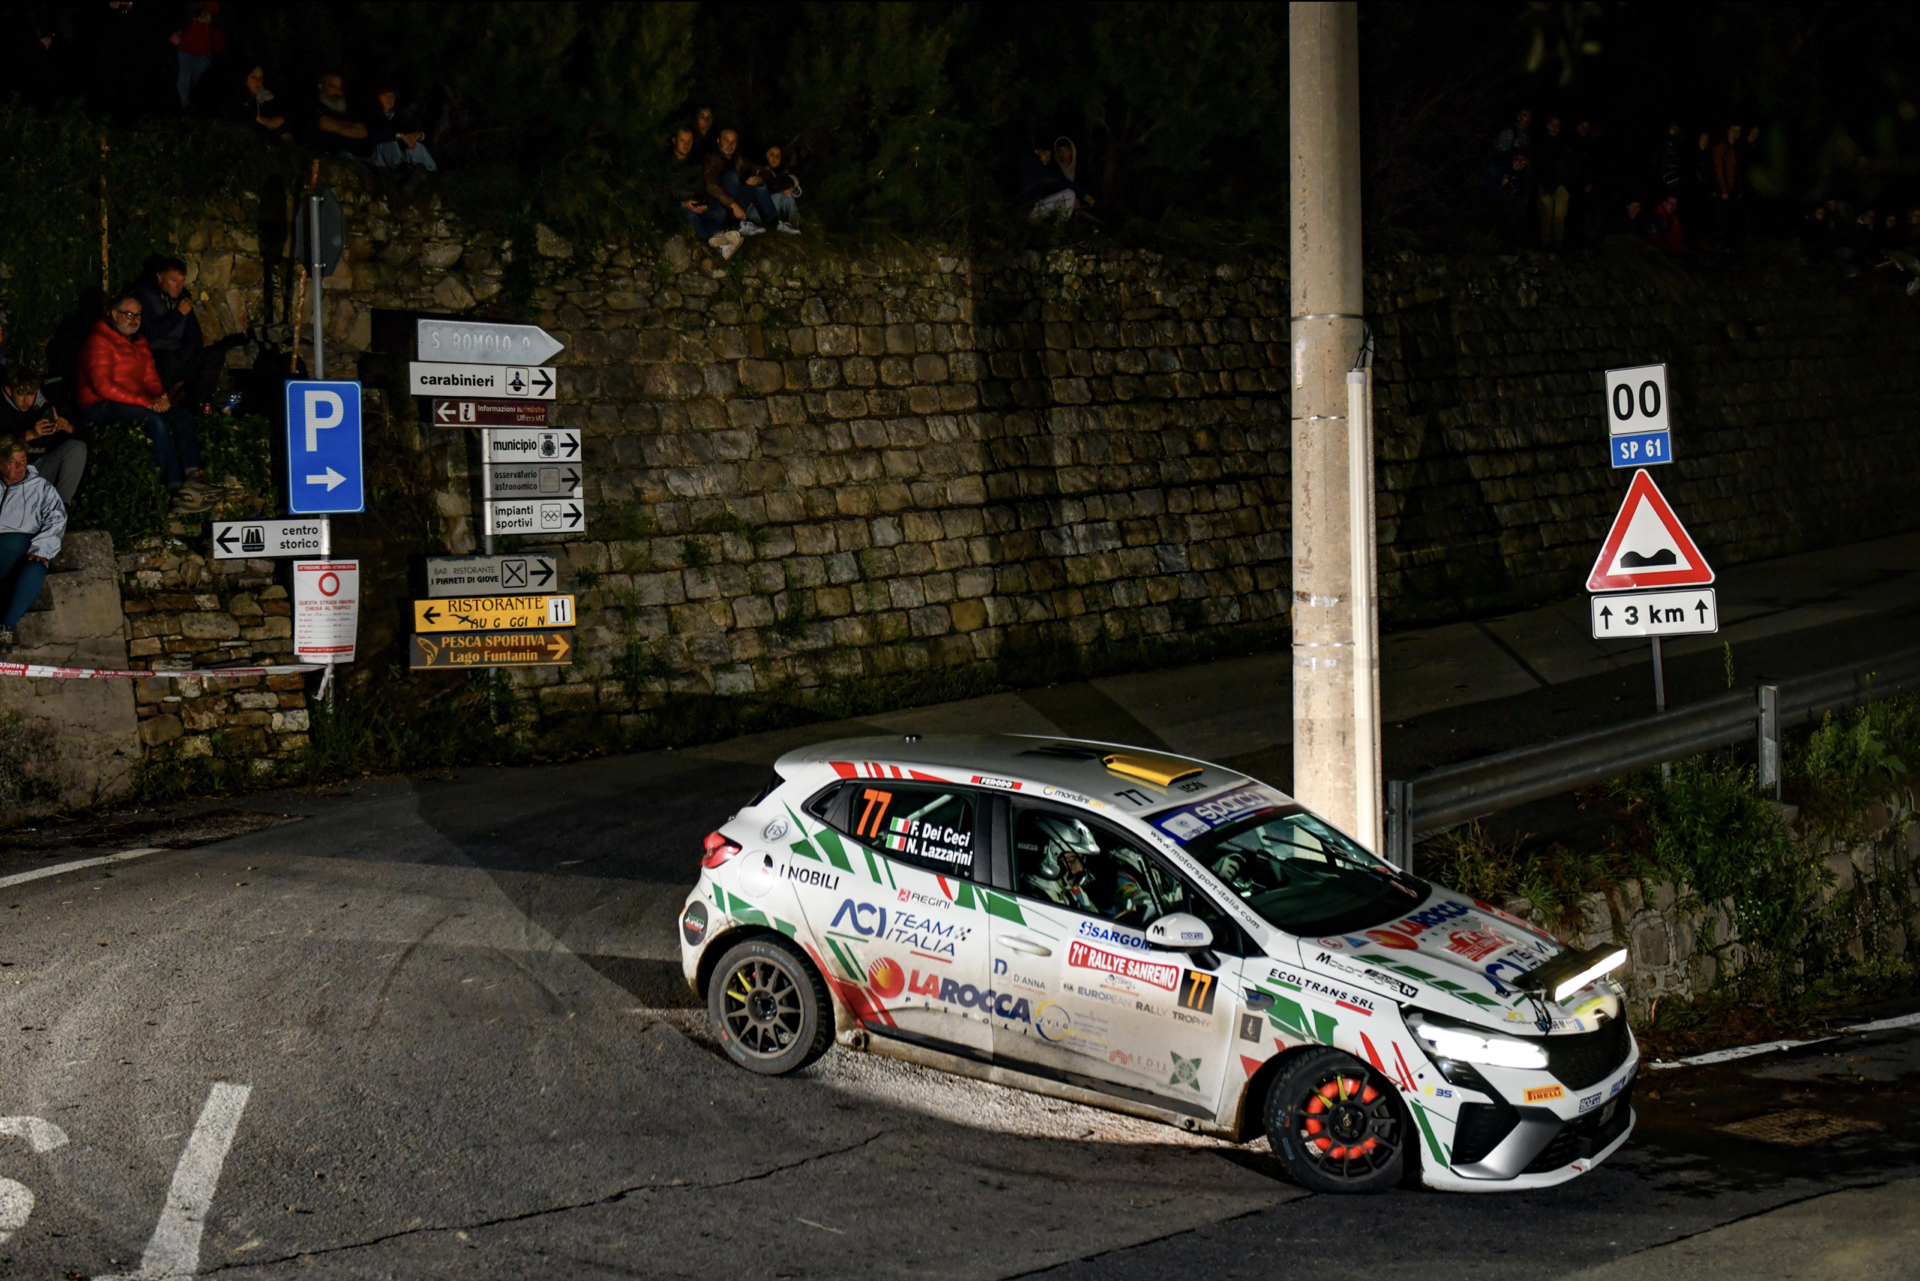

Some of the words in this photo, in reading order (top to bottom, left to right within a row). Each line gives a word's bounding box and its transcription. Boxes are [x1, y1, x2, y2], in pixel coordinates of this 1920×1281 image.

[452, 332, 512, 353] ROMOLO
[420, 374, 494, 387] carabinieri
[477, 404, 516, 413] Informazioni
[1612, 380, 1661, 421] 00
[304, 390, 344, 452] P
[493, 439, 537, 453] municipio
[1620, 441, 1639, 460] SP
[1645, 438, 1662, 457] 61
[494, 470, 538, 479] osservatorio
[494, 481, 538, 491] astronomico
[495, 505, 534, 517] impianti
[282, 525, 319, 536] centro
[495, 518, 533, 529] sportivi
[279, 538, 319, 549] storico
[433, 568, 448, 576] BAR
[453, 566, 495, 575] RISTORANTE
[435, 577, 465, 585] PIANETI
[467, 576, 475, 584] DI
[477, 575, 499, 583] GIOVE
[448, 596, 544, 613] RISTORANTE
[1624, 605, 1639, 626] 3
[1649, 604, 1685, 625] km
[441, 636, 482, 649] PESCA
[485, 634, 546, 648] SPORTIVA
[450, 651, 480, 665] Lago
[484, 649, 538, 662] Funtanin
[980, 777, 1013, 789] FERODO
[1114, 788, 1155, 807] 77
[1195, 787, 1267, 826] sparco
[856, 788, 893, 839] 77
[910, 820, 920, 837] F.
[922, 822, 943, 841] Dei
[943, 827, 971, 847] Ceci
[905, 837, 918, 855] N.
[921, 841, 974, 866] Lazzarini
[787, 865, 840, 891] NOBILI
[1150, 830, 1260, 930] www.motorsport-italia.com
[911, 892, 951, 910] REGINI
[829, 898, 887, 939] ACI
[893, 910, 955, 938] TEAM
[886, 927, 956, 957] ITALIA
[1087, 948, 1127, 975] RALLYE
[1126, 960, 1178, 990] SANREMO
[1013, 973, 1046, 990] D'ANNA
[1063, 982, 1074, 992] FIA
[1187, 970, 1213, 1011] 77
[1269, 967, 1349, 1001] ECOLTRANS
[1350, 994, 1376, 1011] SRL
[908, 968, 1032, 1025] LAROCCA
[1077, 986, 1132, 1008] EUROPEAN
[1135, 1001, 1169, 1017] RALLY
[1172, 1010, 1211, 1028] TROPHY
[1527, 1086, 1562, 1102] PIRELLI
